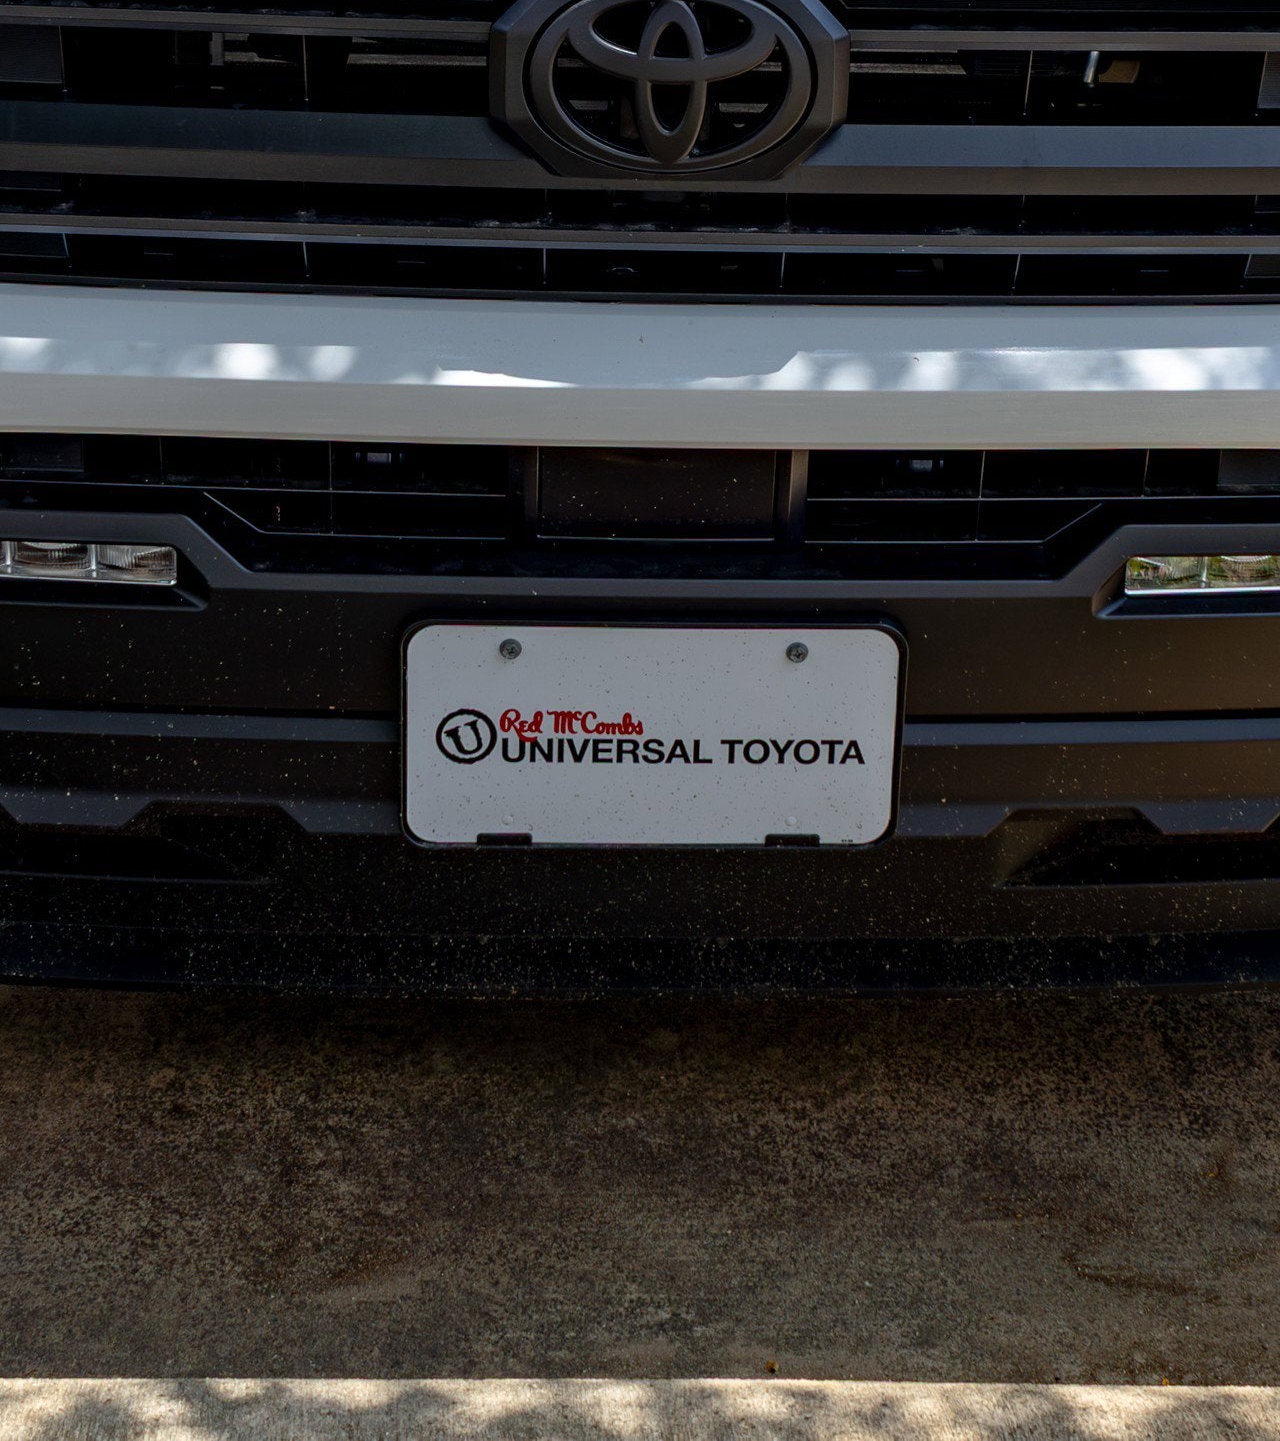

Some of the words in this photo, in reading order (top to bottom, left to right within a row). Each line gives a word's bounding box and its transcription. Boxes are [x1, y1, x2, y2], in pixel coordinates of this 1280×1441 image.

[499, 708, 544, 742] Red
[546, 709, 644, 735] McCombs
[501, 737, 713, 764] UNIVERSAL
[720, 739, 866, 765] TOYOTA
